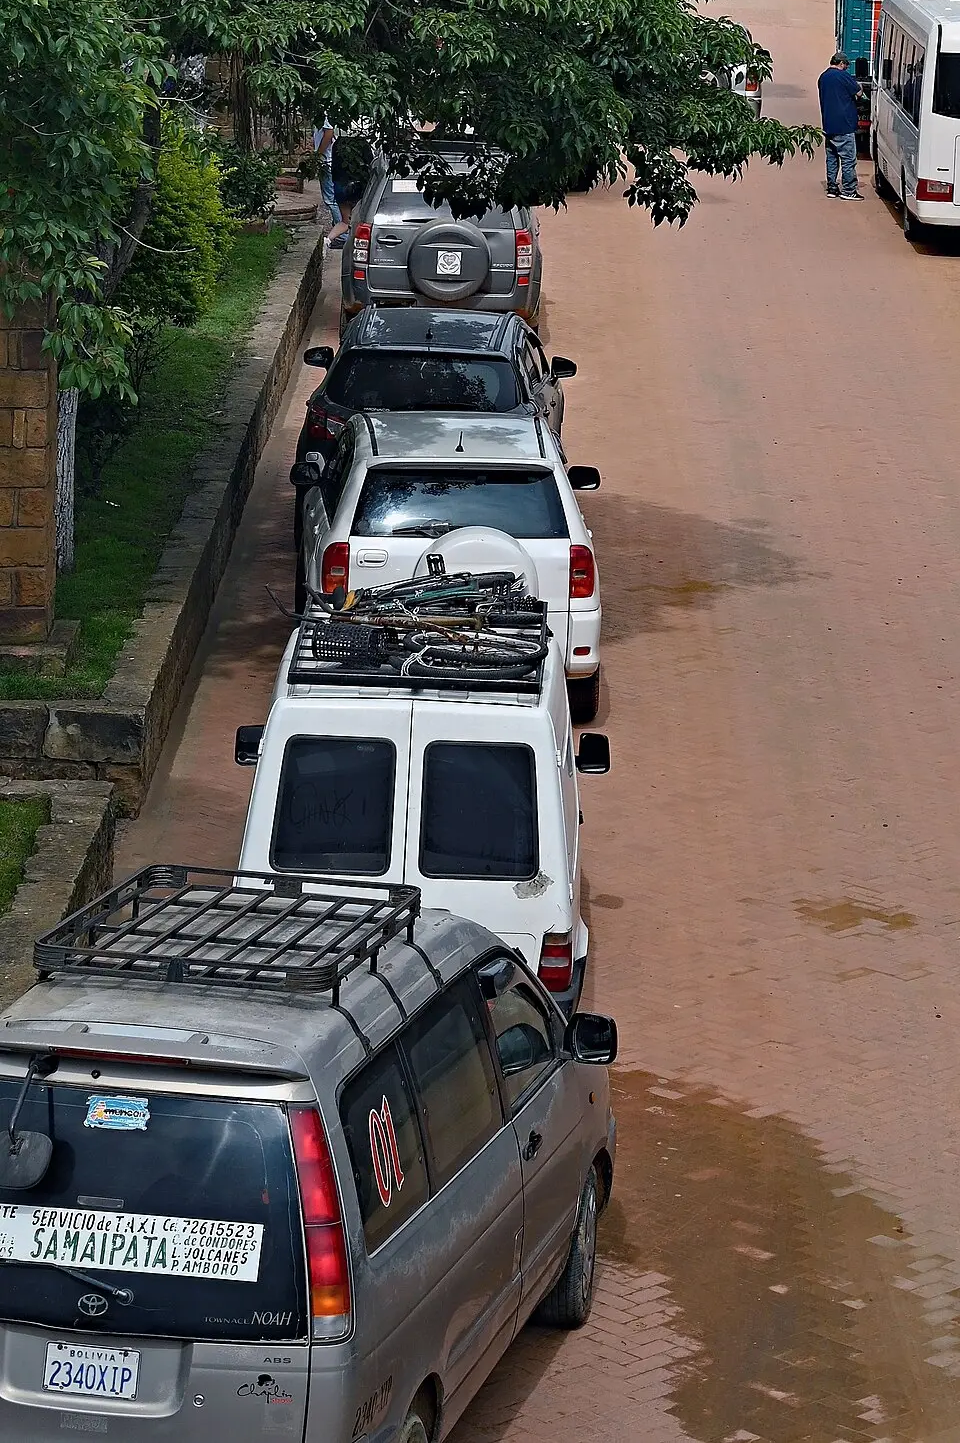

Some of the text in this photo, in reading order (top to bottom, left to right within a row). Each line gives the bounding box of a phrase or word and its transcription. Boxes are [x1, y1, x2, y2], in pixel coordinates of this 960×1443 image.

[369, 1094, 405, 1207] 01
[0, 1205, 18, 1219] TE
[31, 1209, 94, 1230] SERVICIO
[96, 1216, 112, 1232] de
[182, 1219, 256, 1239] 72615523
[30, 1227, 168, 1269] SAMAIPATA
[183, 1234, 198, 1247] de
[199, 1235, 257, 1252] CONDORES
[184, 1247, 249, 1265] VOLCANES
[170, 1259, 239, 1276] P. AMBORO
[250, 1311, 293, 1326] NOAH
[70, 1349, 116, 1362] BOLIVIA
[48, 1360, 132, 1394] 2340XIP
